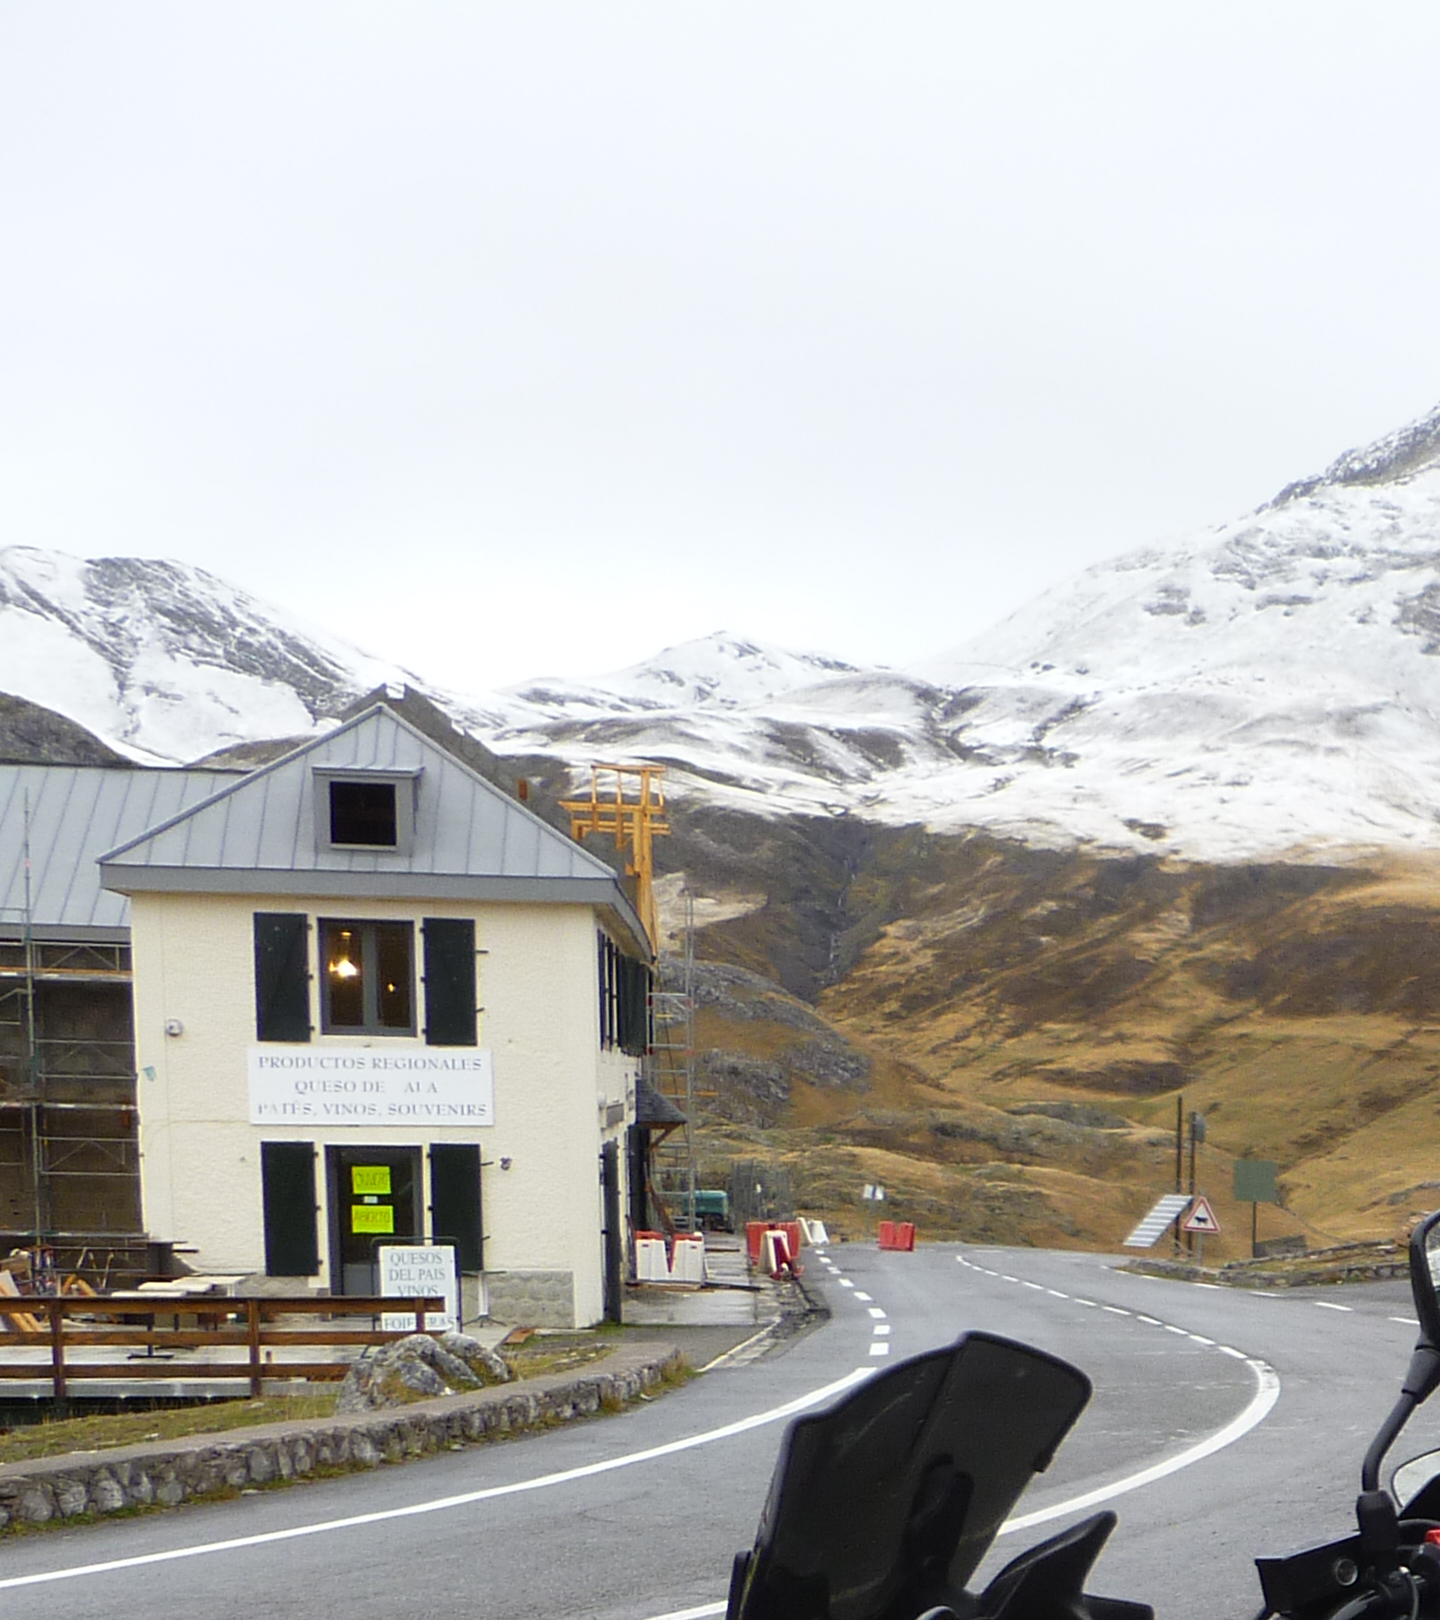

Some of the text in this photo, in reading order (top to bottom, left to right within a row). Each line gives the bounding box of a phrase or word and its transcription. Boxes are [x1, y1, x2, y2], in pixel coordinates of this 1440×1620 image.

[258, 1056, 483, 1071] PRODUCTOS REGIONALES
[294, 1080, 357, 1095] QUESO
[362, 1080, 386, 1093] DE
[387, 1103, 488, 1117] SOUVENIRS
[390, 1252, 443, 1266] QUESOS
[389, 1269, 415, 1282] DEL
[397, 1284, 439, 1297] VINOS
